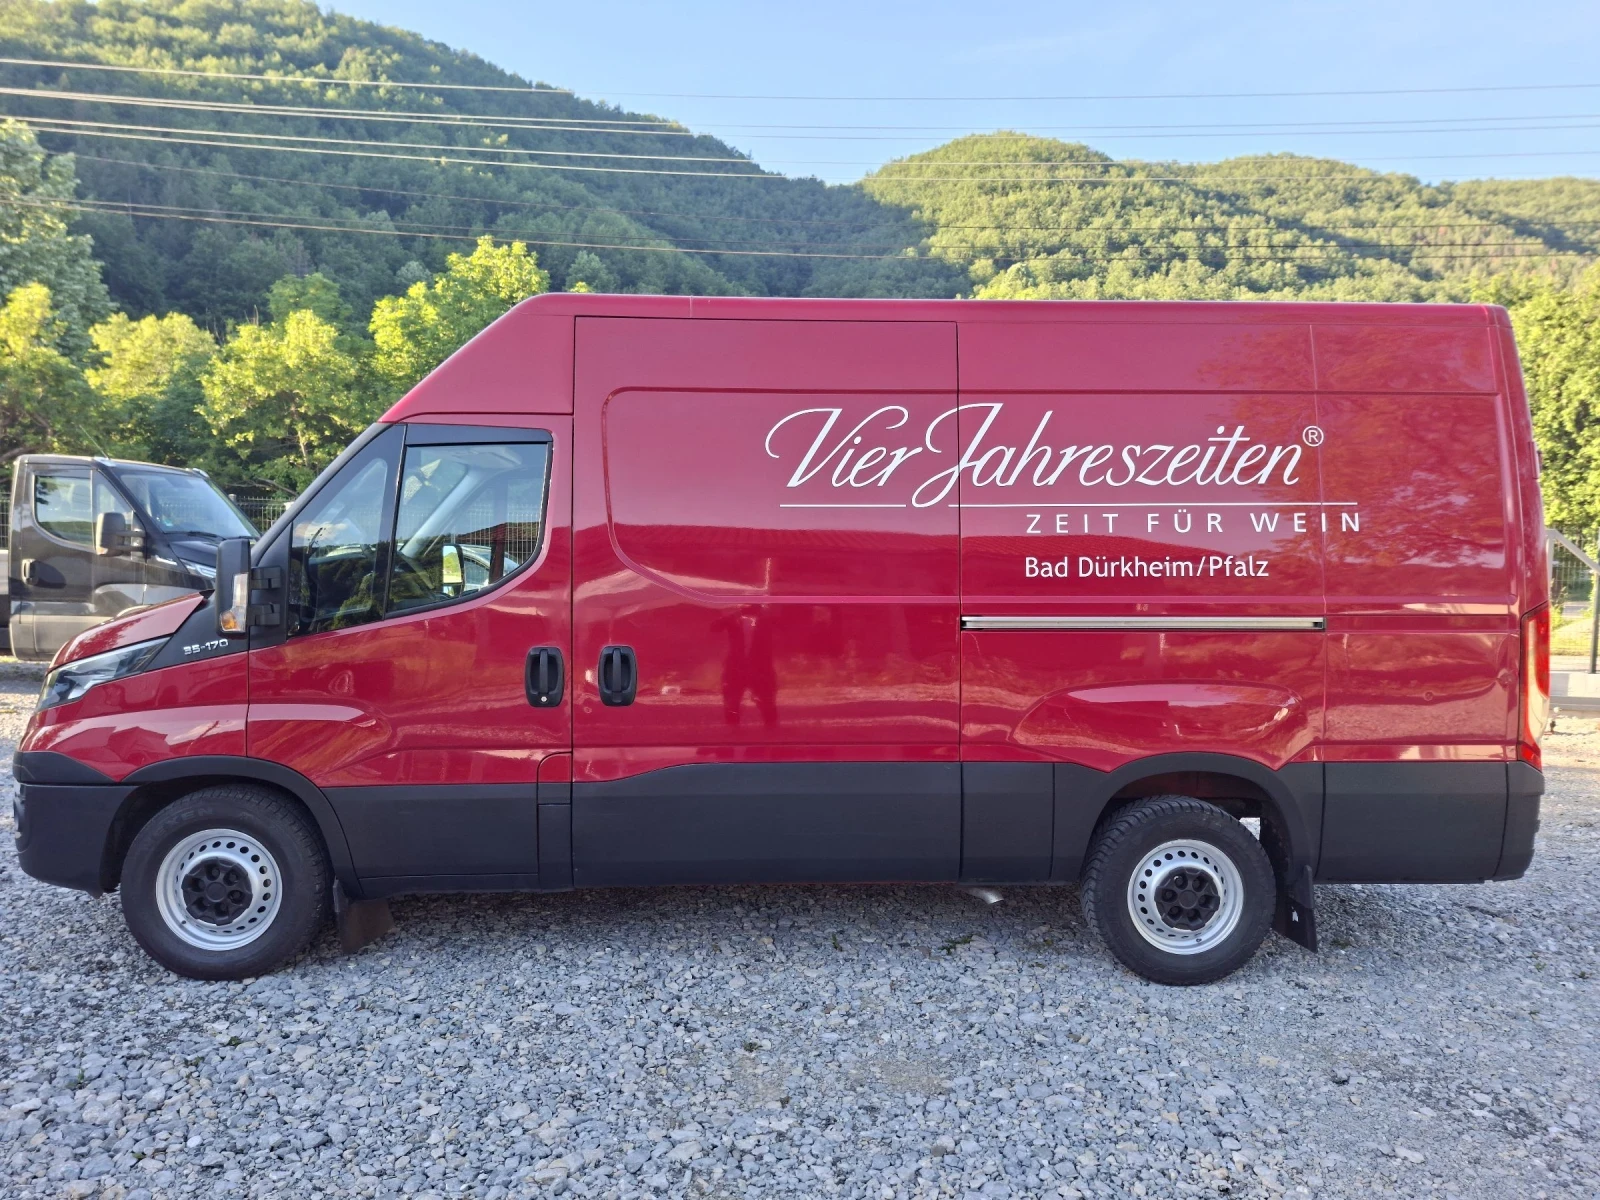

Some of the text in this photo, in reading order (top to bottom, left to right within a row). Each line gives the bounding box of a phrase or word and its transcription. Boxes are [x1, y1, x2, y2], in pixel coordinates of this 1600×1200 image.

[765, 405, 923, 487] Vier
[1026, 509, 1360, 534] ZEIT FÜR WEIN
[1025, 555, 1269, 578] Bad Dürkheim/Pfalz
[183, 638, 229, 655] 35-170
